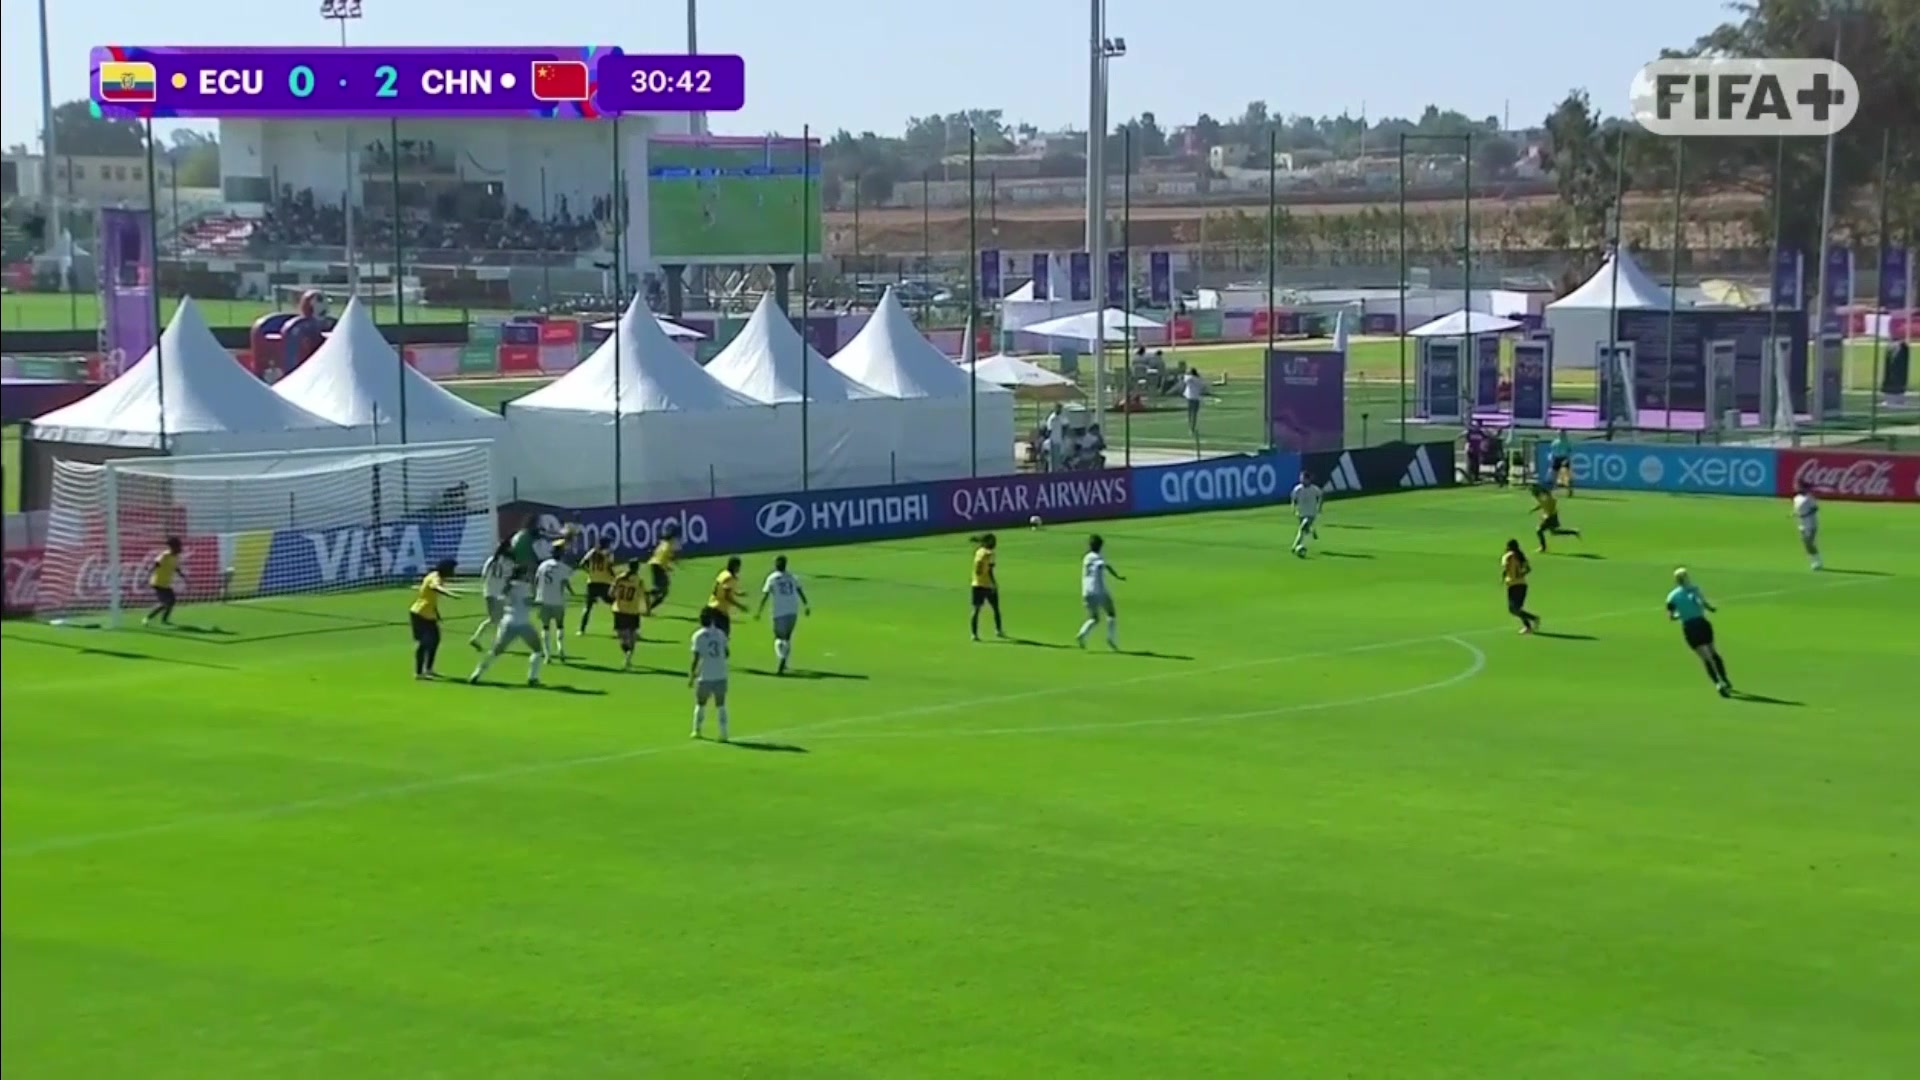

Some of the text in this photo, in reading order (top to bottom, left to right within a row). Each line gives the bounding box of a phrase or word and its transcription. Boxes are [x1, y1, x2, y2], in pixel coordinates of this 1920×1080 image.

[1160, 464, 1277, 502] aramco
[1570, 453, 1627, 482] ero
[1678, 457, 1767, 487] xero
[811, 495, 928, 530] HYUNDAI
[952, 477, 1127, 520] QATAR AIRWAYS
[301, 524, 427, 582] VISA
[708, 640, 721, 658] 3
